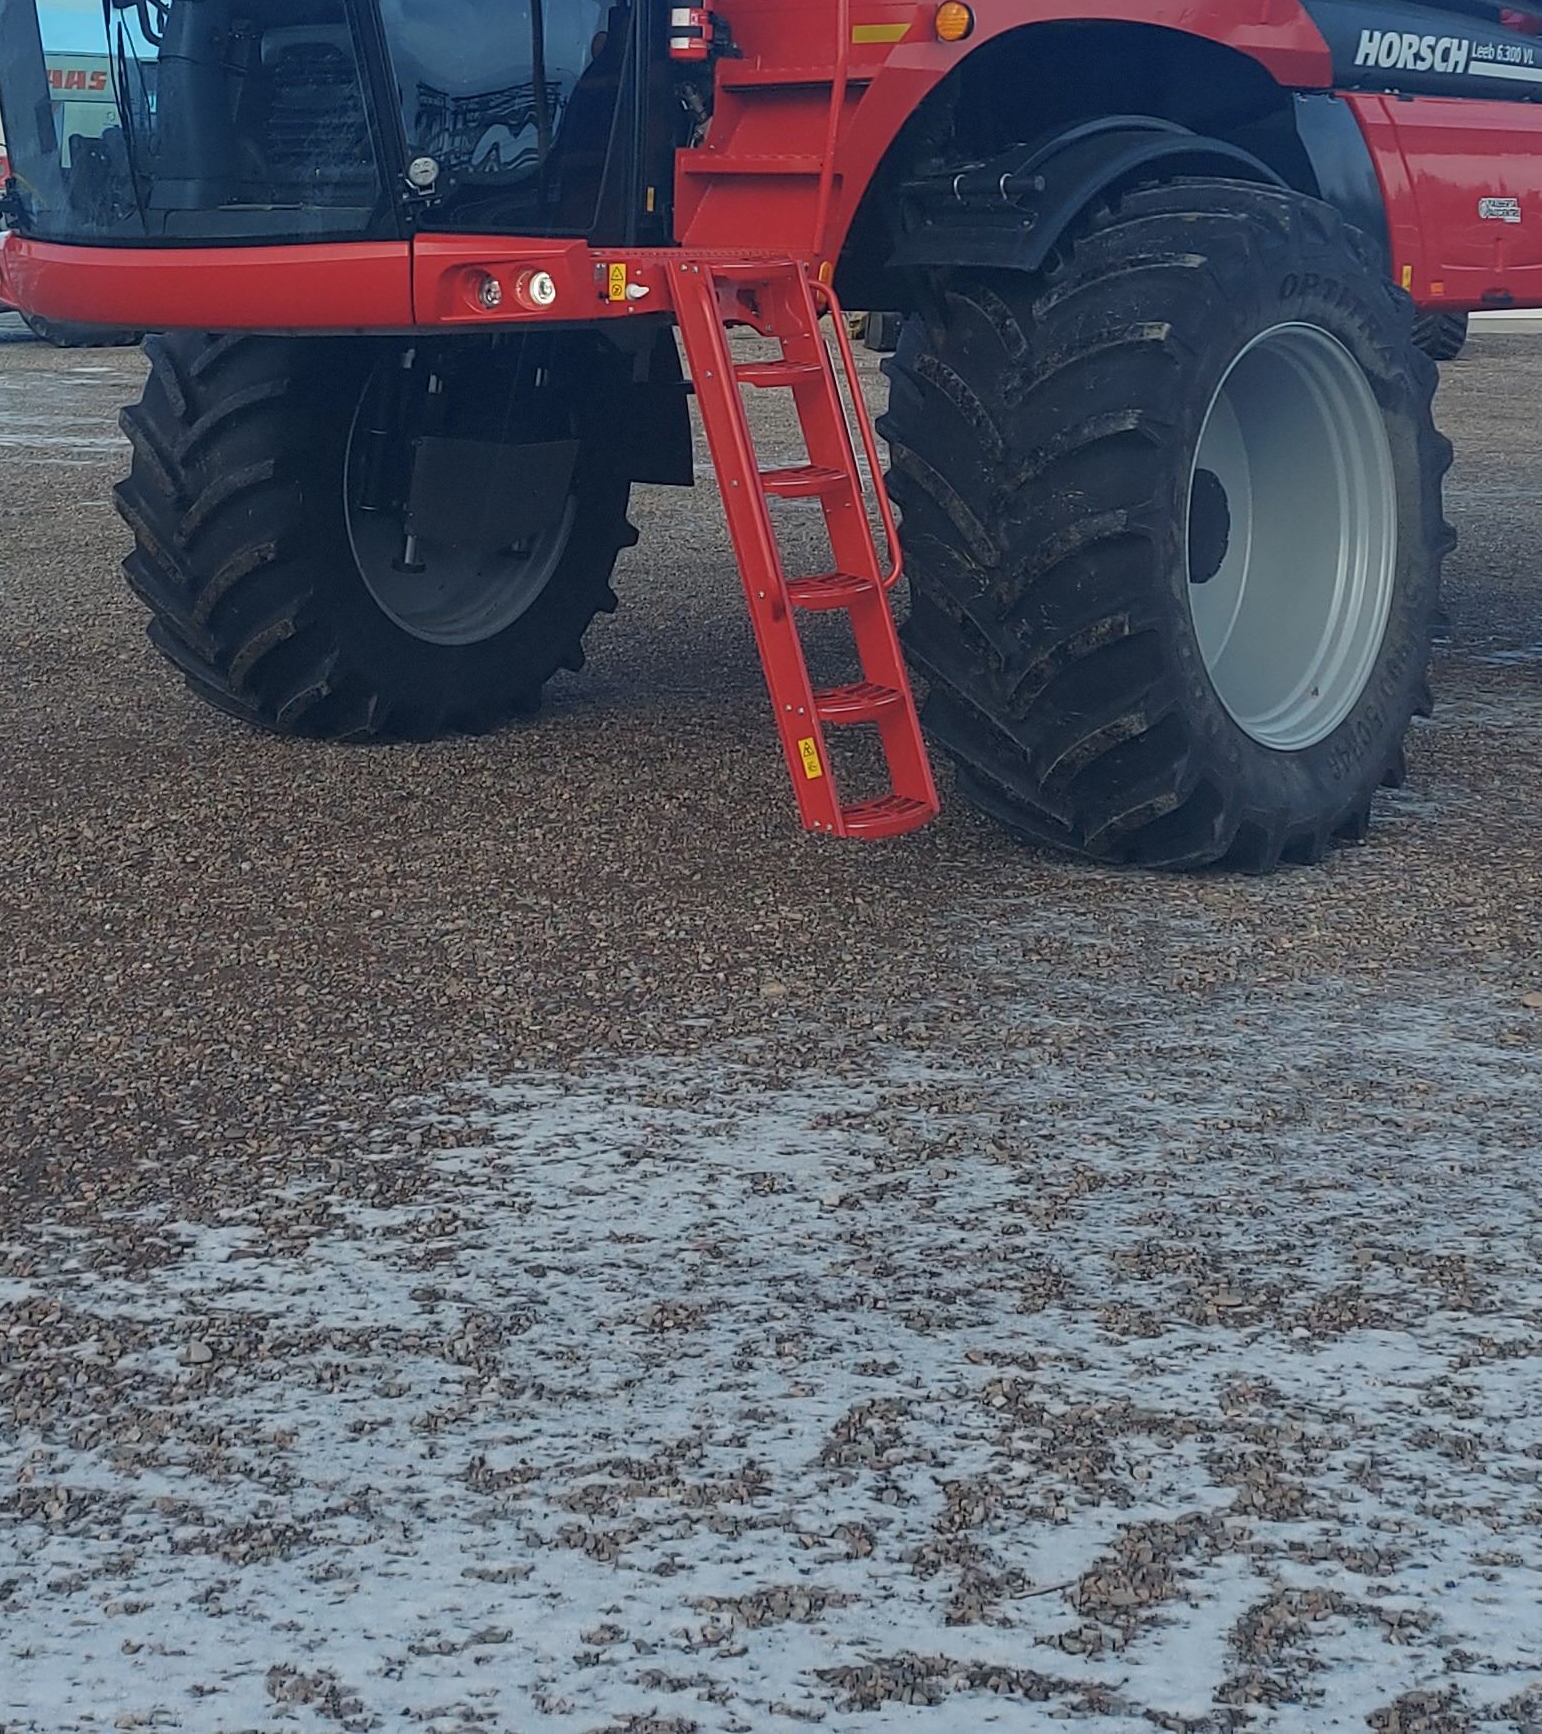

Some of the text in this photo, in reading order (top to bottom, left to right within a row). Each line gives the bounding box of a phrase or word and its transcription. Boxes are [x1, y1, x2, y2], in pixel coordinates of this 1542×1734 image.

[1353, 29, 1470, 74] HORSCH
[1471, 42, 1495, 59] Leeb
[1523, 47, 1535, 65] VL
